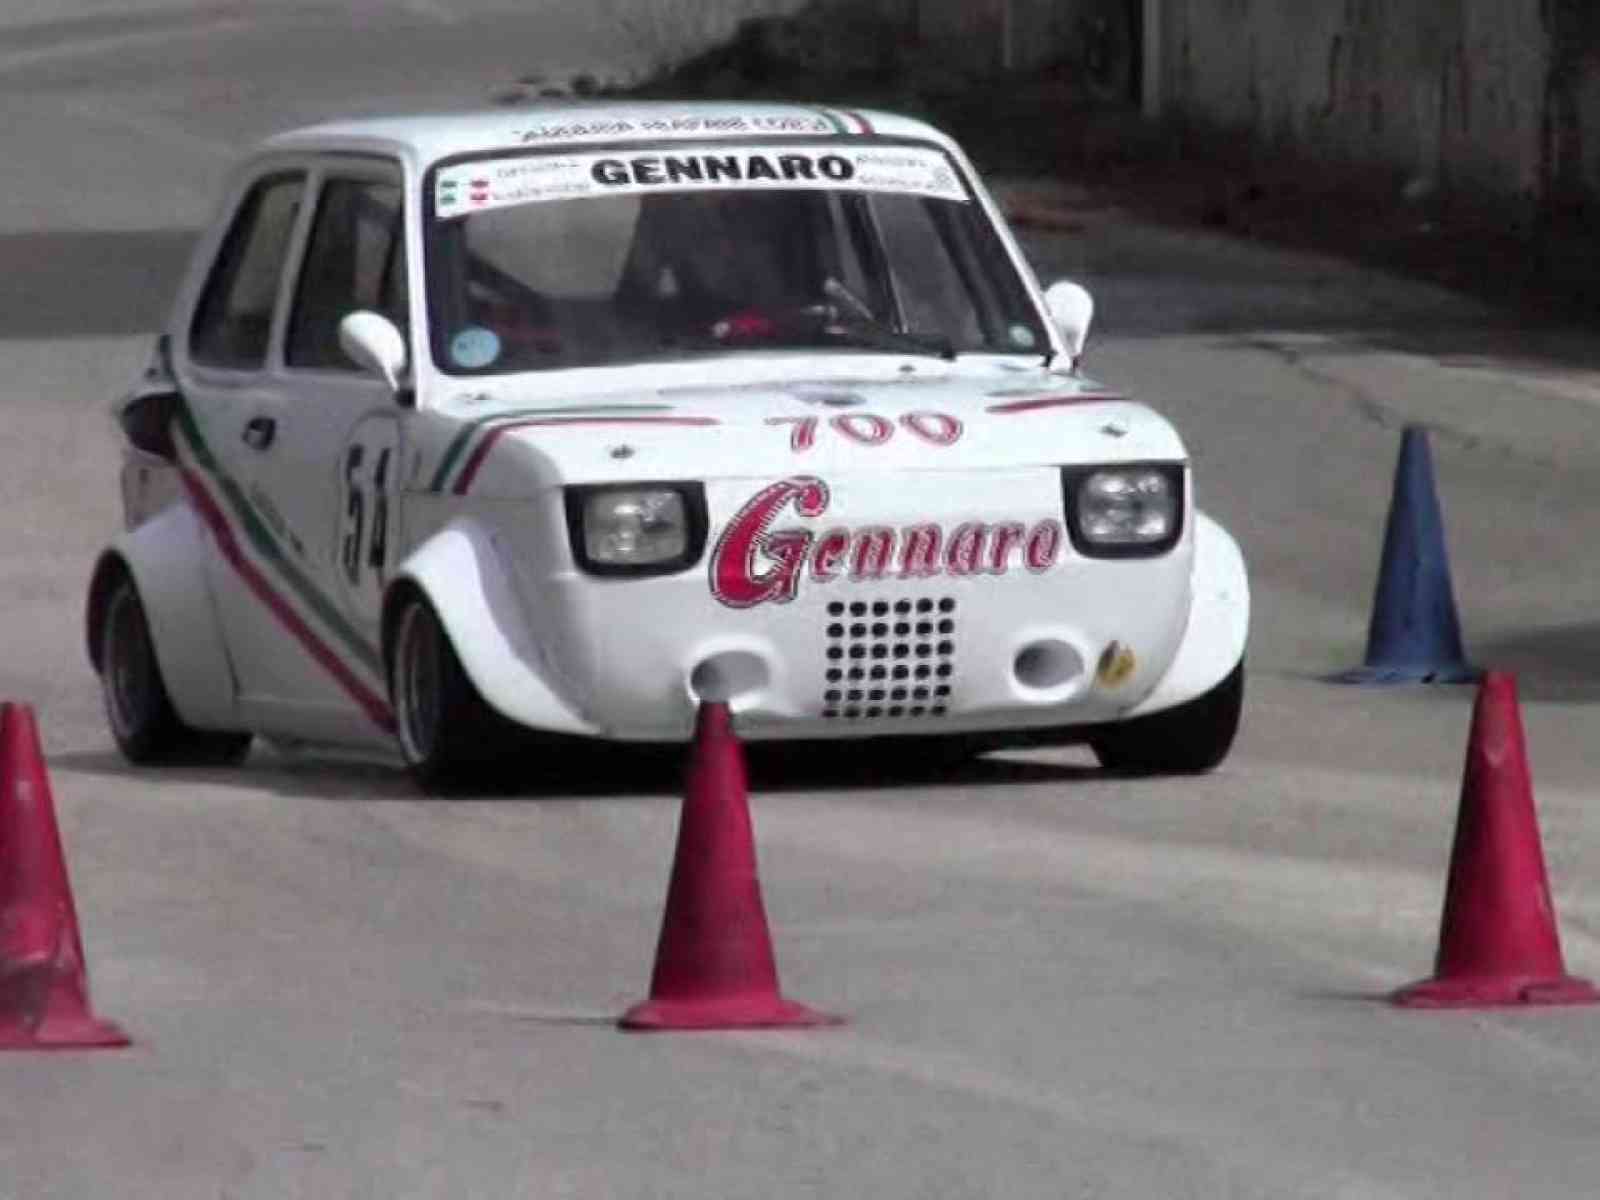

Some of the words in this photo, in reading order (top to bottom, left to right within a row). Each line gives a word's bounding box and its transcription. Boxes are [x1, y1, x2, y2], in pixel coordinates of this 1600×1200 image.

[590, 154, 854, 186] GENNARO
[764, 410, 963, 452] 700
[709, 475, 1061, 608] Gennaro
